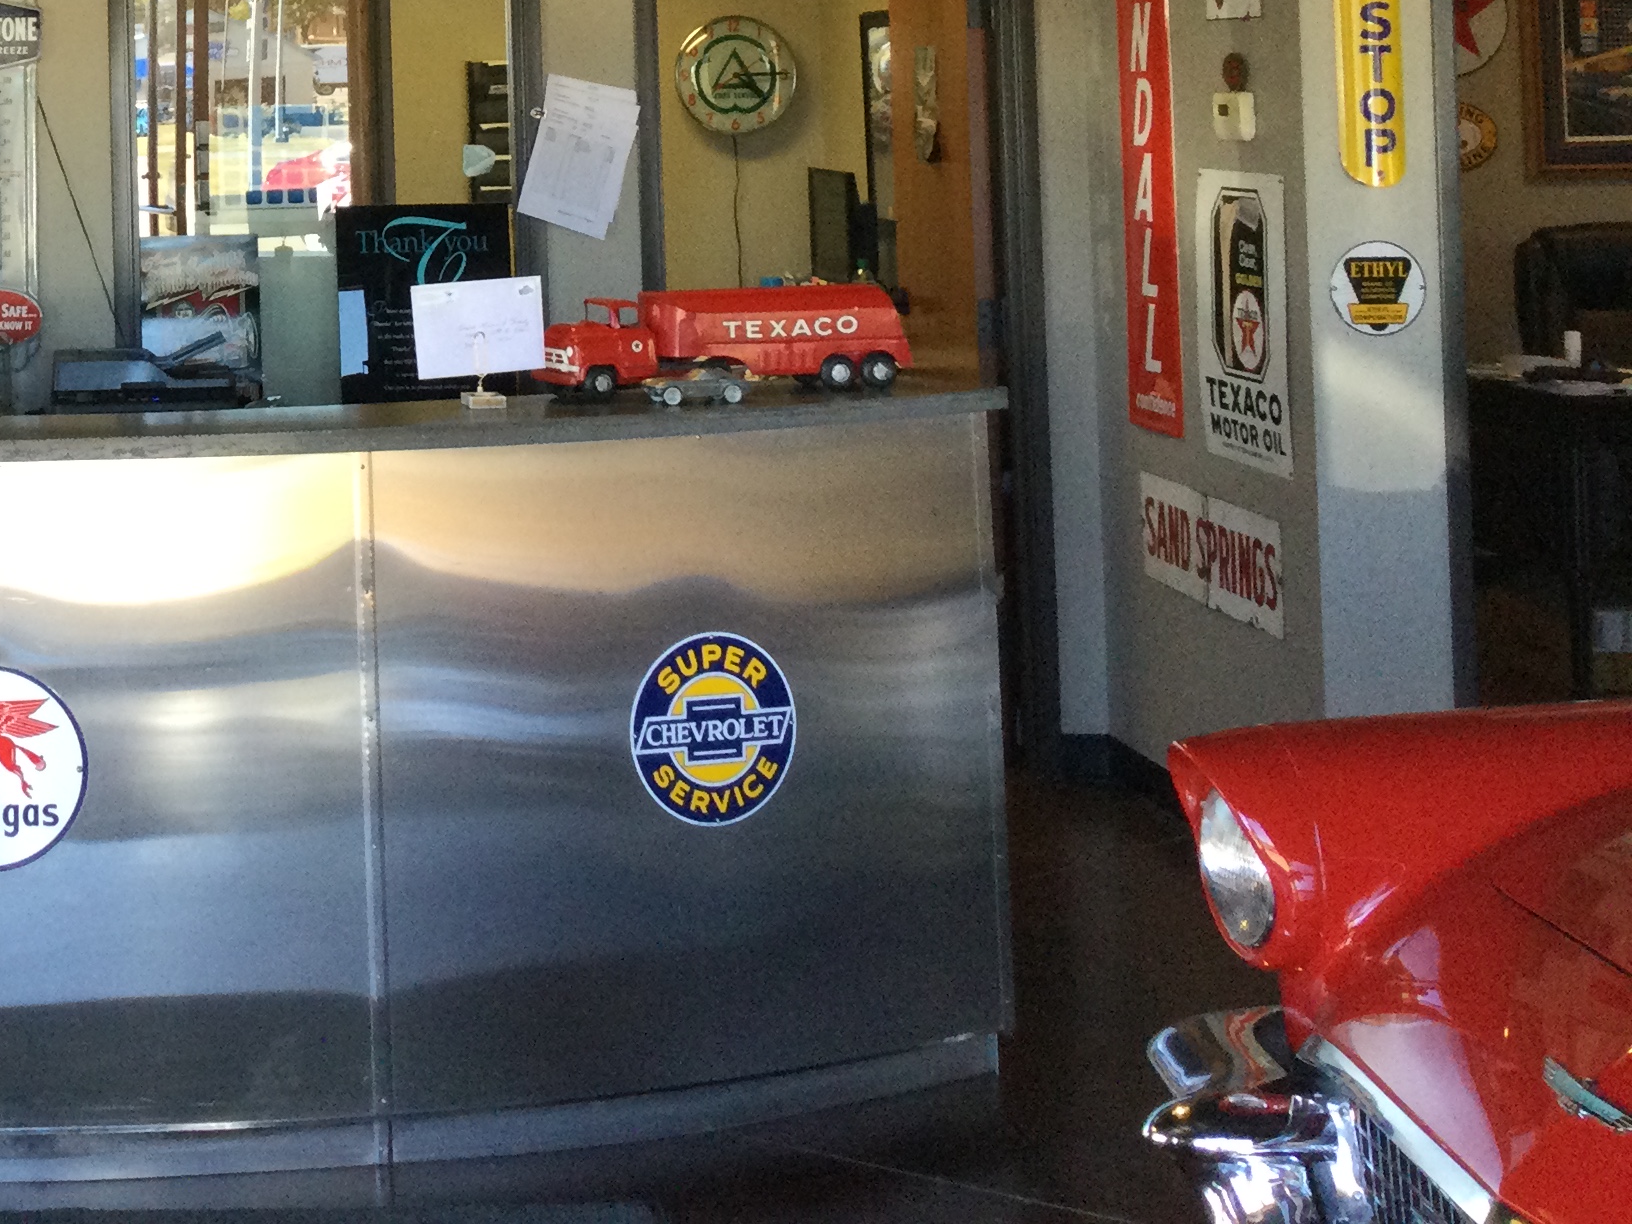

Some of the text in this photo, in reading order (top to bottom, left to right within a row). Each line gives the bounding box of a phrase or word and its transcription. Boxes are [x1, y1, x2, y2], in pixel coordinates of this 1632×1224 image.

[1359, 1, 1397, 167] STOP
[355, 228, 489, 260] Thank you
[1350, 261, 1408, 278] ETHYL
[722, 315, 859, 339] TEXACO
[1206, 376, 1282, 427] TEXACO
[1210, 412, 1260, 448] MOTOR
[1263, 428, 1287, 457] OIL
[1145, 496, 1279, 612] SAND SPRINGS
[657, 643, 767, 695] SUPER
[645, 715, 784, 747] CHEVROLET
[653, 756, 779, 814] SERVICE
